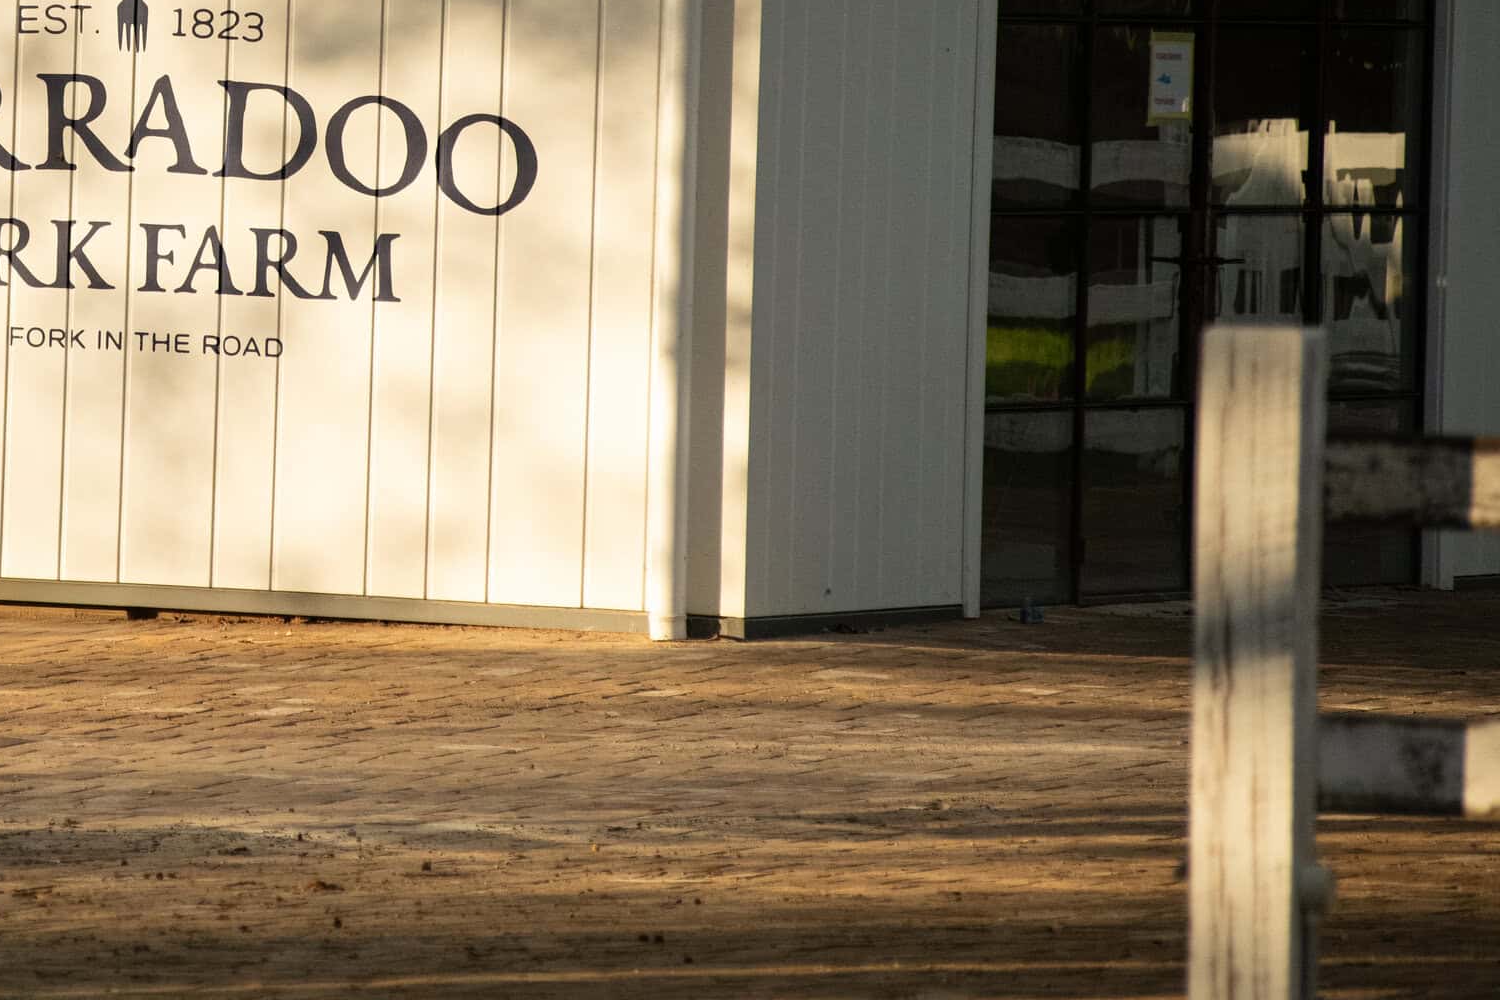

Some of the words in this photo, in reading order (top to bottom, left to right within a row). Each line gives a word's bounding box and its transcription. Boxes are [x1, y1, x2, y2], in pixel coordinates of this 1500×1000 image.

[18, 4, 100, 35] EST.
[172, 8, 265, 42] 1823
[137, 223, 401, 302] FARM
[9, 327, 86, 349] FORK
[97, 330, 123, 351] IN
[134, 331, 191, 354] THE
[202, 335, 284, 358] ROAD
